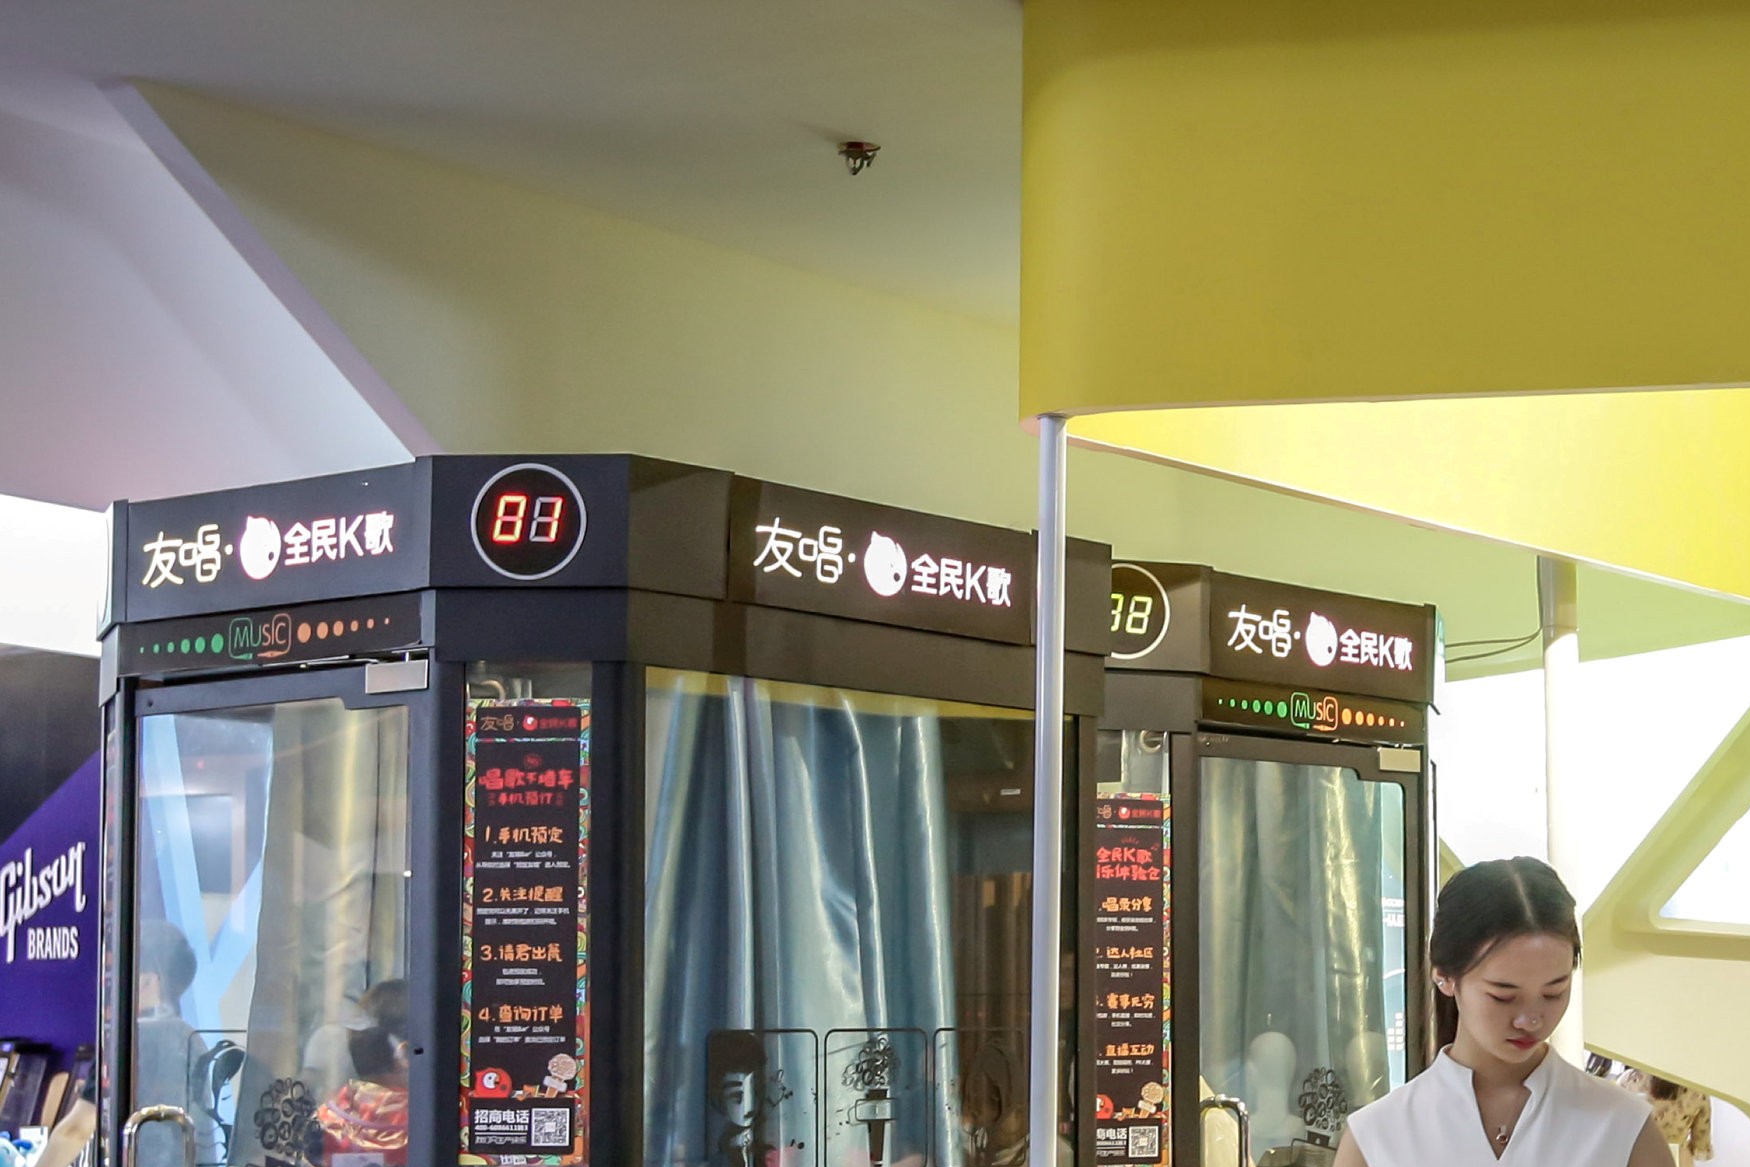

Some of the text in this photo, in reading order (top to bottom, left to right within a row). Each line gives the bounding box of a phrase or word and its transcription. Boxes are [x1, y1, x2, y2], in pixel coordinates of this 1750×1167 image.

[283, 511, 395, 567] 全民K歌
[911, 553, 1012, 607] 全民K歌
[231, 617, 290, 652] MUSIC
[1339, 628, 1413, 670] 全民K歌
[1292, 695, 1337, 727] MUSIC
[1096, 864, 1161, 881] 乐体验仓
[0, 841, 86, 964] Gibson
[27, 926, 79, 960] BRANDS
[474, 1109, 530, 1125] 招商电话
